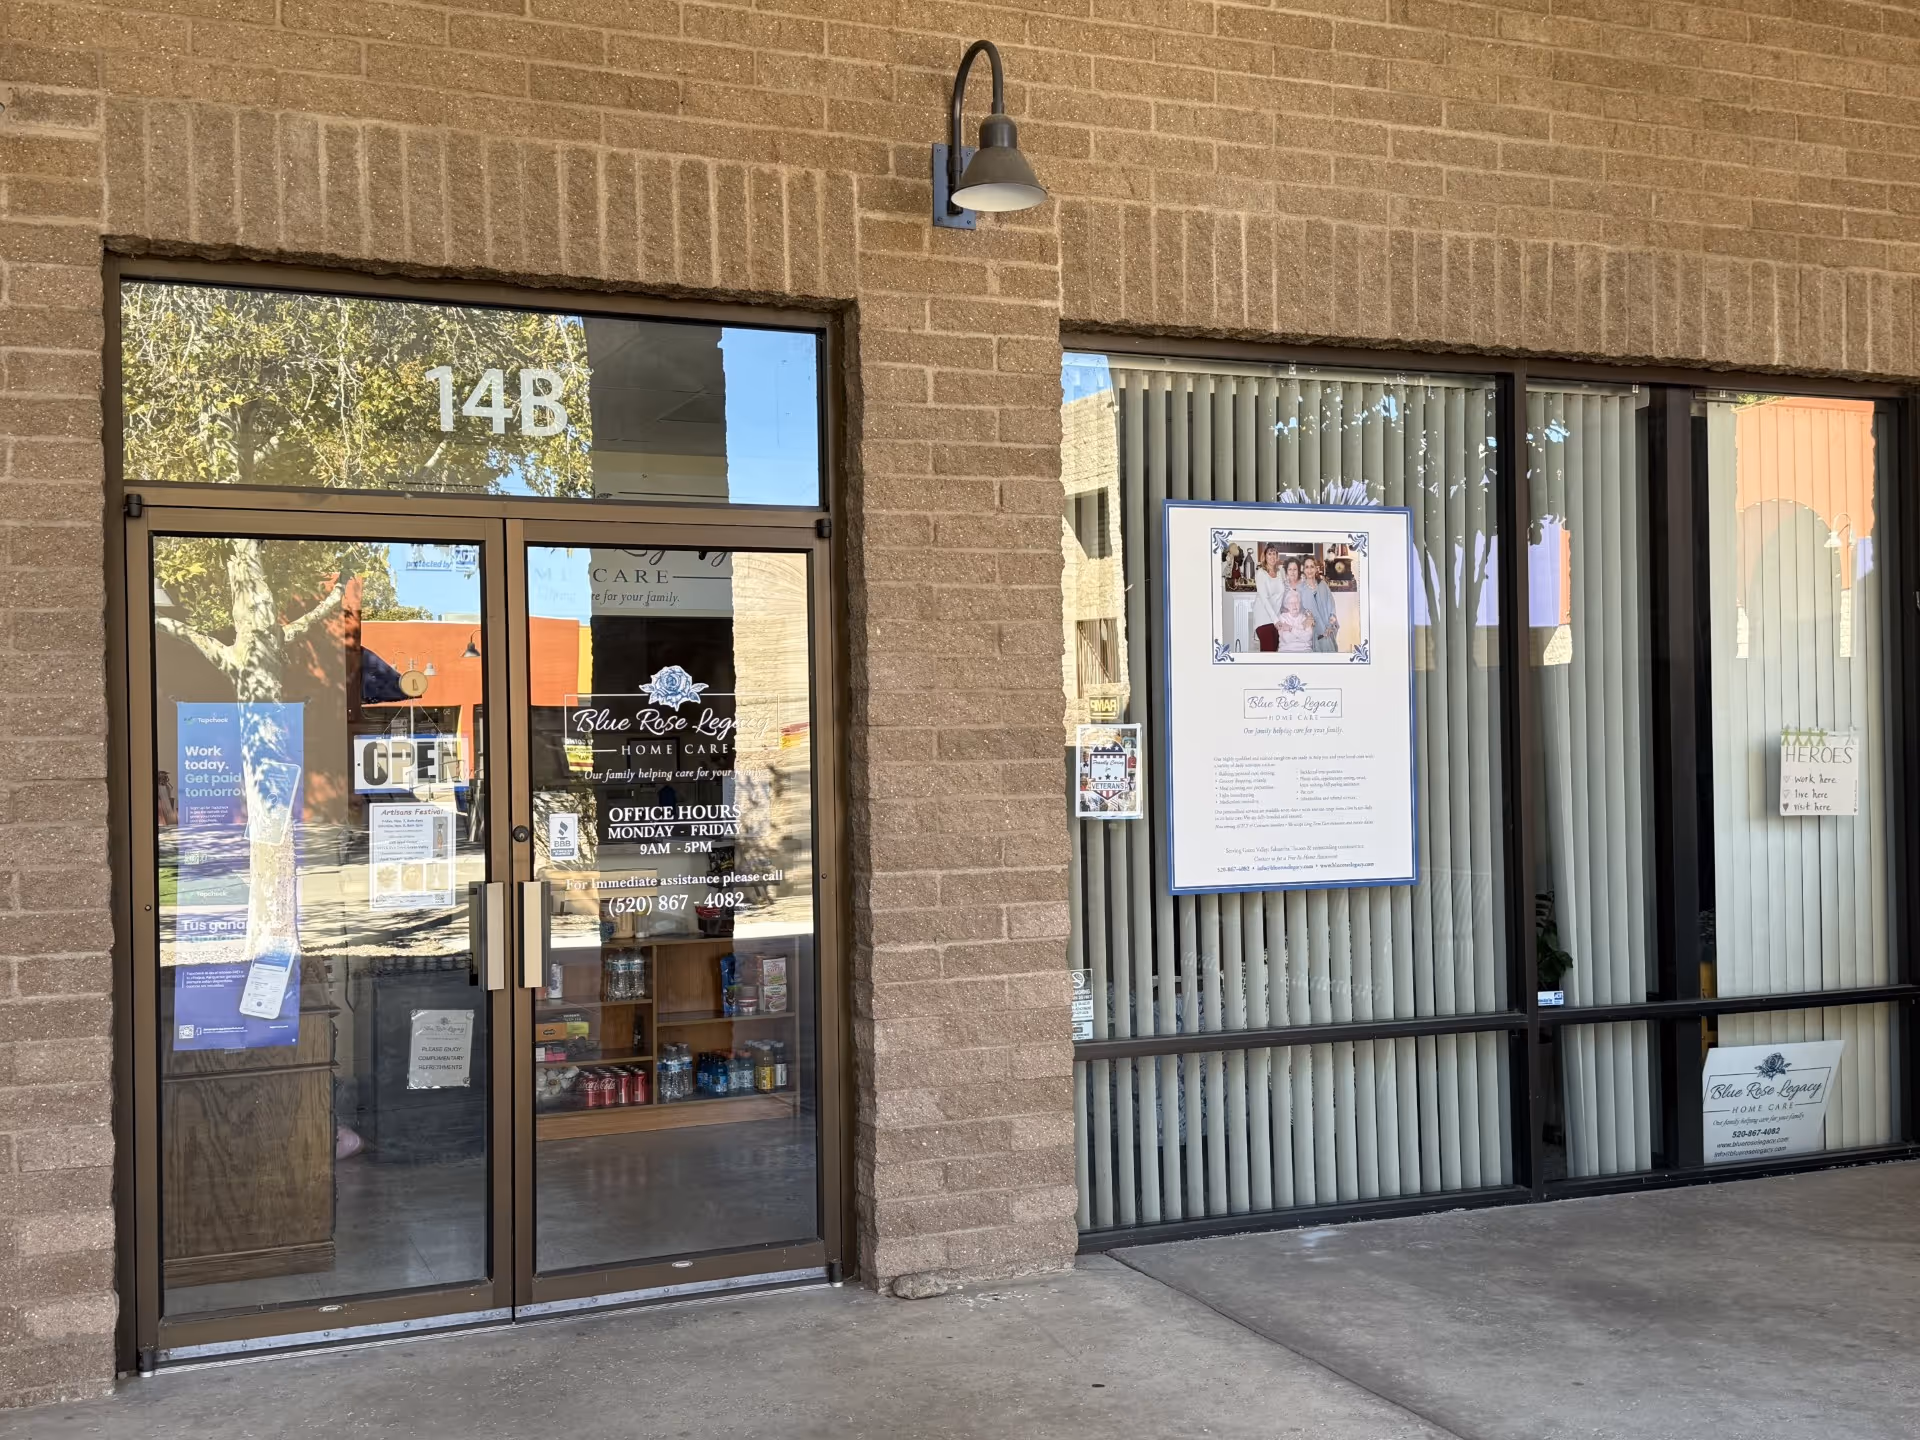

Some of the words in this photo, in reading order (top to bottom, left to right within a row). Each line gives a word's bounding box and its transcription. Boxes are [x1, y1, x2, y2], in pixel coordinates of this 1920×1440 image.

[424, 365, 568, 437] 14B
[406, 560, 441, 569] protected
[592, 568, 669, 584] CARE
[600, 590, 617, 605] for
[620, 593, 643, 605] your
[646, 591, 681, 607] family.
[1247, 696, 1274, 709] Blue
[1276, 696, 1300, 711] Rose
[1301, 695, 1338, 714] Legacy
[572, 708, 631, 733] Blue
[636, 708, 688, 732] Rose
[184, 745, 222, 757] Work
[621, 744, 673, 755] HOME
[685, 743, 730, 754] CARE
[1785, 746, 1854, 765] HEROES
[184, 759, 230, 773] today.
[363, 740, 463, 786] OPEN
[185, 773, 210, 784] Get
[212, 772, 242, 787] paid
[584, 770, 602, 781] Our
[602, 769, 635, 784] family
[638, 768, 673, 782] helping
[675, 769, 694, 778] care
[694, 767, 709, 781] for
[709, 769, 732, 781] your
[1794, 774, 1815, 784] work
[1819, 773, 1837, 784] here
[1092, 782, 1124, 790] VETERANS
[1795, 788, 1808, 798] live
[1812, 788, 1828, 798] here
[608, 806, 674, 823] OFFICE
[677, 803, 742, 820] HOURS
[1794, 801, 1810, 811] visit
[1814, 801, 1832, 811] here
[607, 825, 675, 840] MONDAY
[690, 823, 743, 837] FRIDAY
[553, 840, 572, 848] BBB
[640, 842, 670, 856] 9AM
[684, 841, 713, 854] 5PM
[565, 879, 587, 891] For
[660, 874, 720, 887] assistance
[722, 871, 760, 887] please
[762, 869, 783, 882] call
[608, 896, 653, 918] (520)
[658, 894, 689, 911] 867
[703, 891, 746, 909] 4082
[1710, 1083, 1743, 1100] Blue
[1746, 1081, 1775, 1100] Rose
[1777, 1079, 1822, 1101] Legacy
[1731, 1104, 1763, 1114] HOME
[1768, 1102, 1795, 1111] CARE
[1731, 1127, 1781, 1139] 520-867-4082
